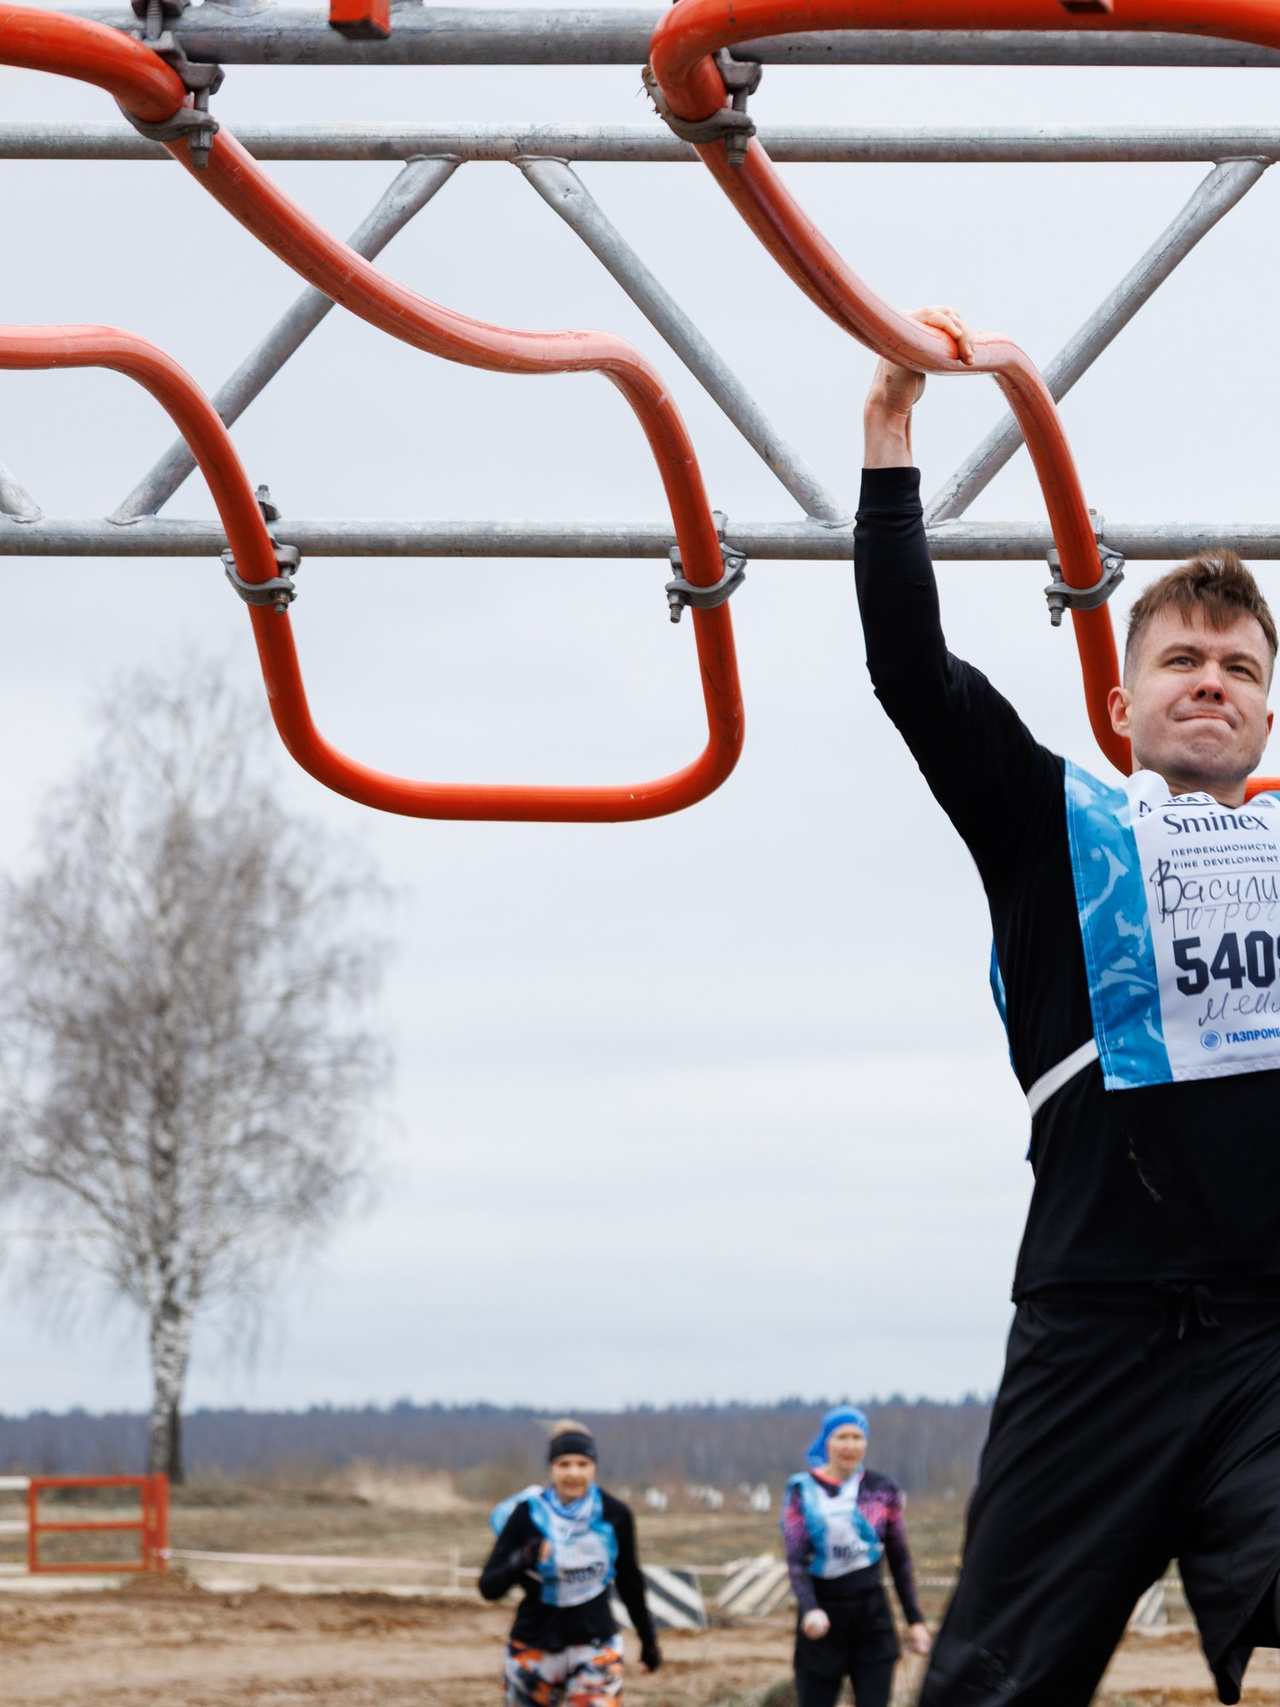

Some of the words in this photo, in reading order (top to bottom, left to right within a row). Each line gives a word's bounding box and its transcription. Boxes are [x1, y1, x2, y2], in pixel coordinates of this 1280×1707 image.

[1163, 811, 1269, 835] Sminex
[1170, 843, 1277, 857] ПЕРФЕКЦИОНИСТЫ
[1173, 859, 1198, 870] FINE
[1203, 856, 1280, 867] DEVELOPMENT
